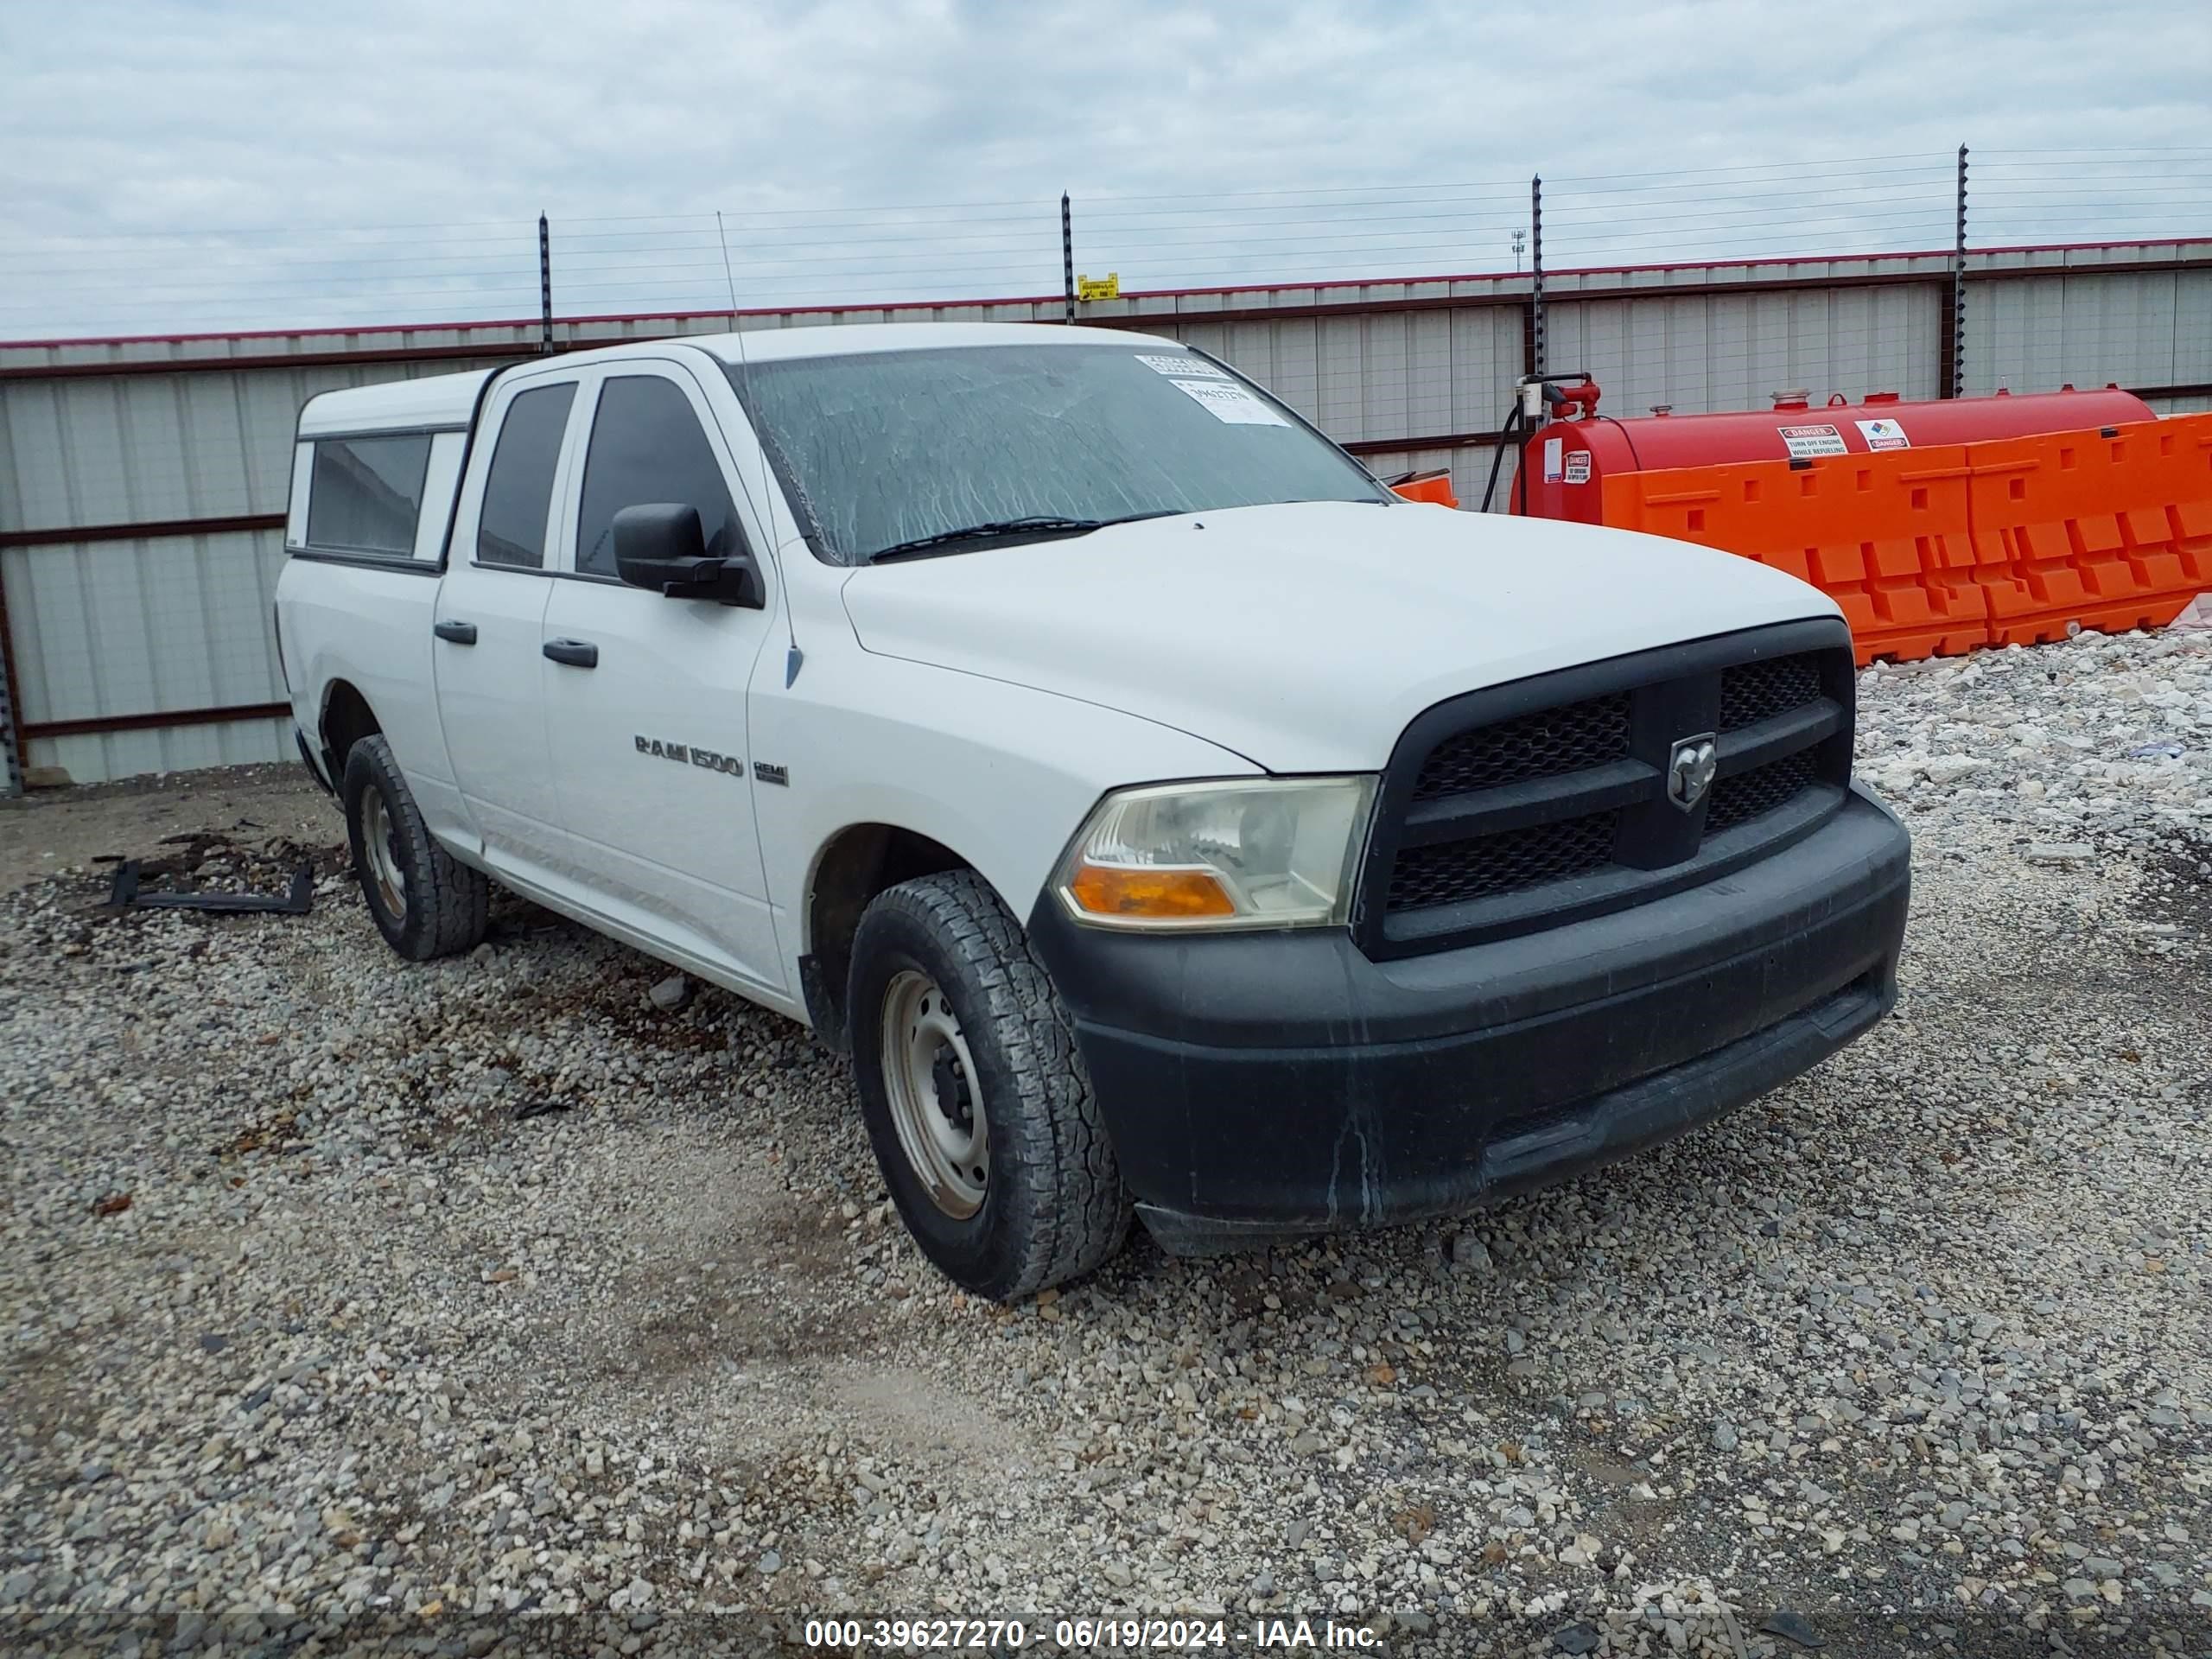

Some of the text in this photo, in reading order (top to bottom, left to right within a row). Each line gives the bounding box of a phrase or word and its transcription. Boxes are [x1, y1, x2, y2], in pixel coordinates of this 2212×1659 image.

[1790, 427, 1827, 436] DANGER
[1874, 439, 1902, 448] DANGER
[1813, 447, 1846, 455] REFUELING
[635, 735, 744, 777] RAM 1500
